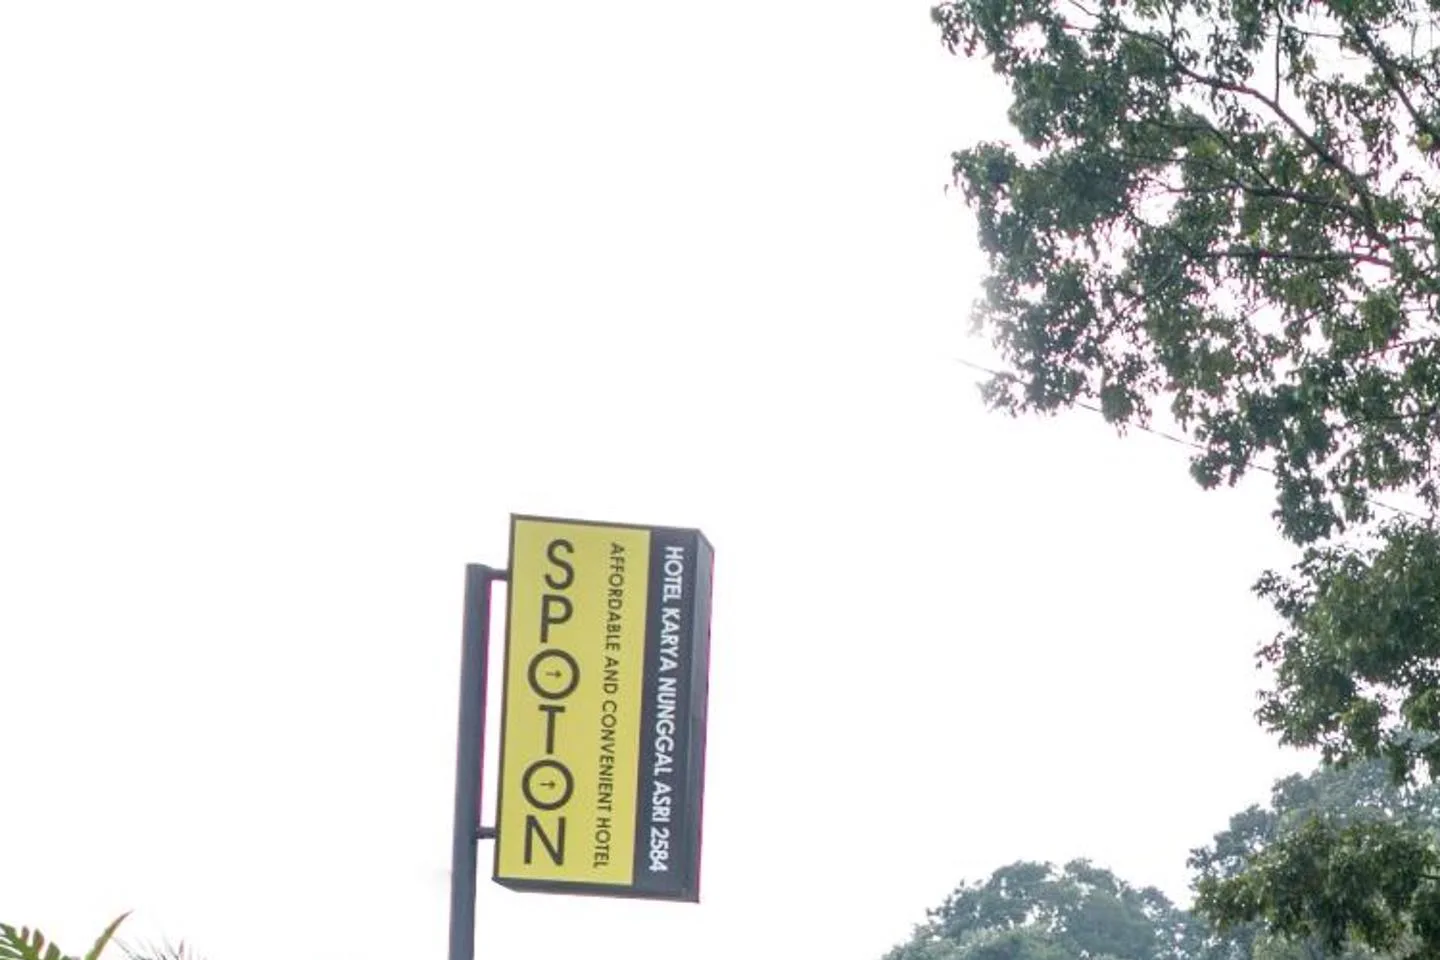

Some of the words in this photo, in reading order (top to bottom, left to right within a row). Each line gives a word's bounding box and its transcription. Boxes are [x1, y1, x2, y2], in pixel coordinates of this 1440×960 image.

[605, 542, 625, 652] AFFORDABLE
[662, 546, 684, 603] HOTEL
[658, 607, 681, 672] KARYA
[603, 656, 620, 695] AND
[654, 677, 678, 776] NUNGGAL
[597, 699, 618, 812] CONVENIENT
[651, 780, 673, 823] ASRI
[593, 816, 611, 868] HOTEL
[648, 827, 670, 873] 2584
